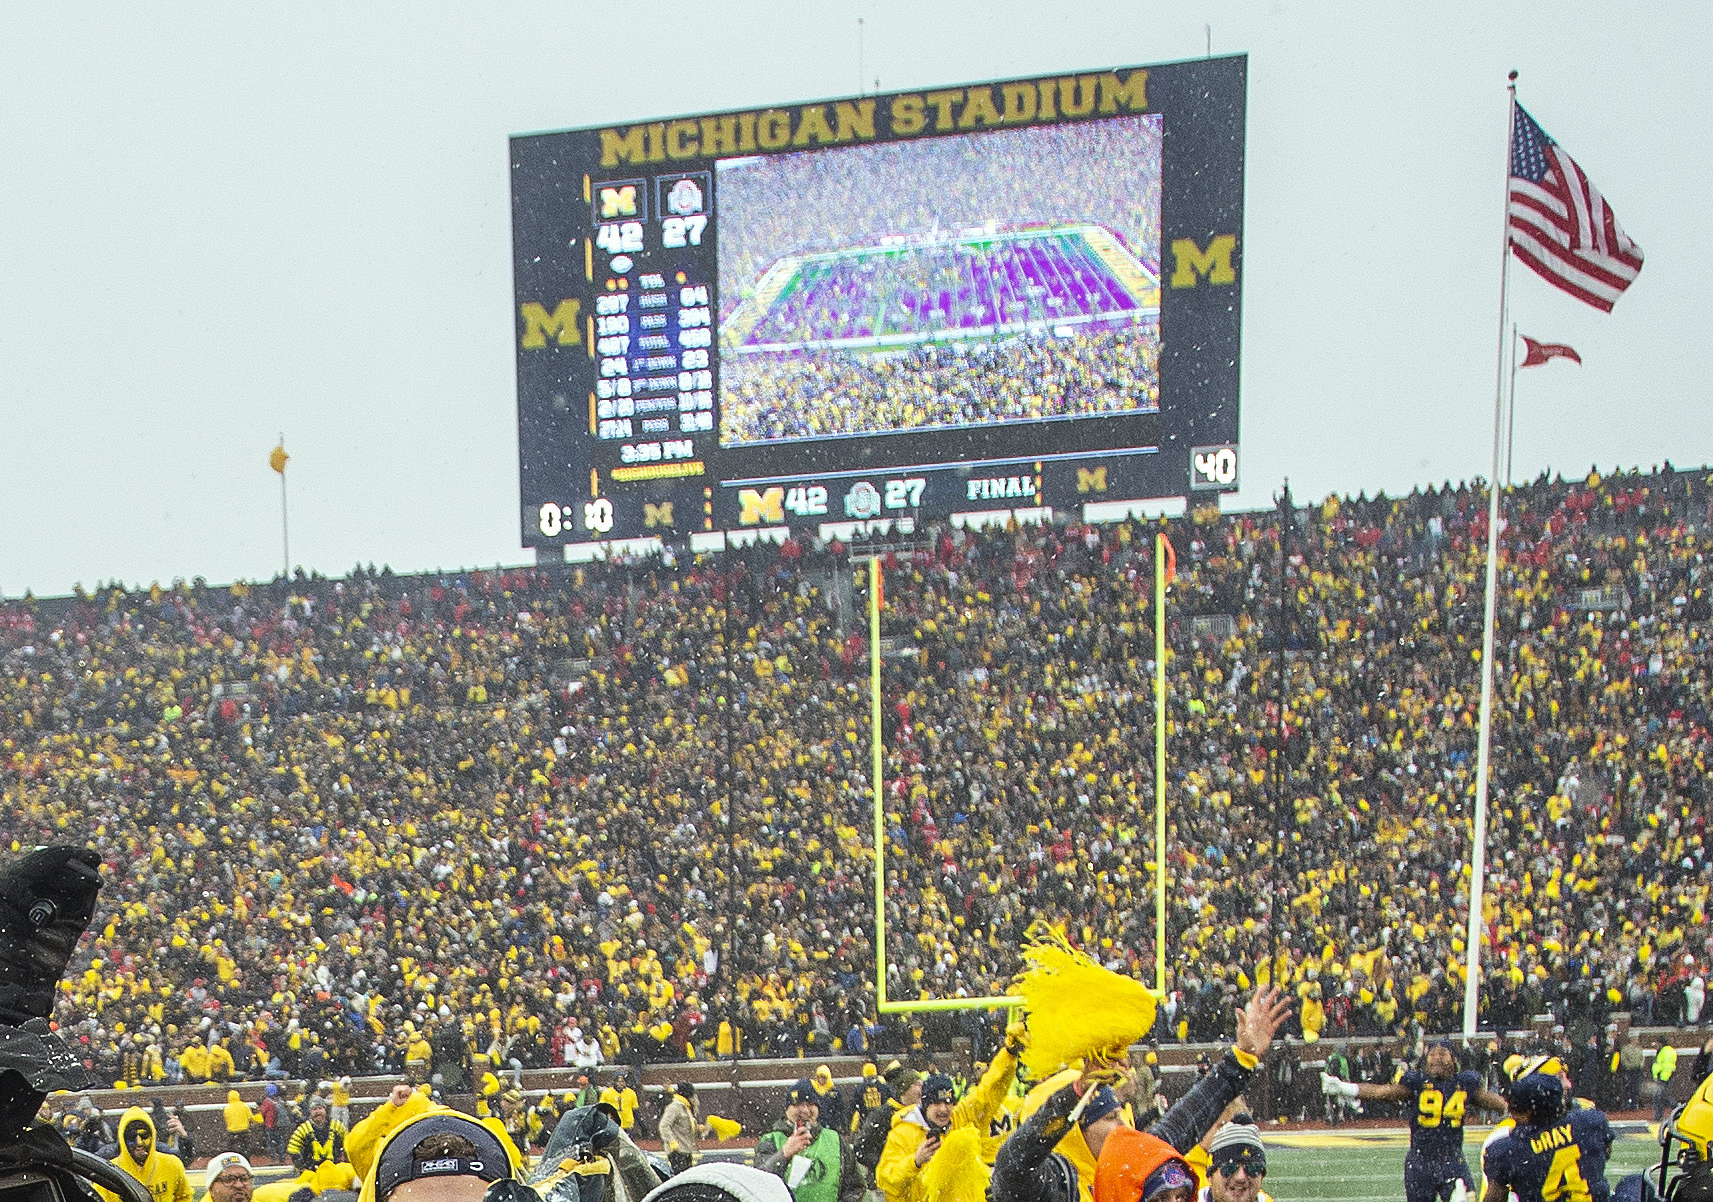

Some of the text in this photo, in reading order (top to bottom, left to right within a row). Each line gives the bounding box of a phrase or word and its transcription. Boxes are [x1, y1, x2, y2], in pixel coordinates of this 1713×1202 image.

[600, 71, 1149, 169] MICHIGAN STADIUM
[600, 186, 637, 218] M
[596, 215, 707, 254] 42 27
[1170, 233, 1235, 290] M
[521, 298, 581, 350] M
[600, 356, 628, 378] 24
[662, 440, 694, 460] PM
[1195, 449, 1236, 484] 40
[1076, 466, 1107, 492] M
[643, 501, 673, 528] M
[738, 475, 1036, 525] M 42 27 FINAL
[1417, 1090, 1467, 1128] 94
[312, 1139, 334, 1161] M
[1531, 1123, 1573, 1154] GRAY
